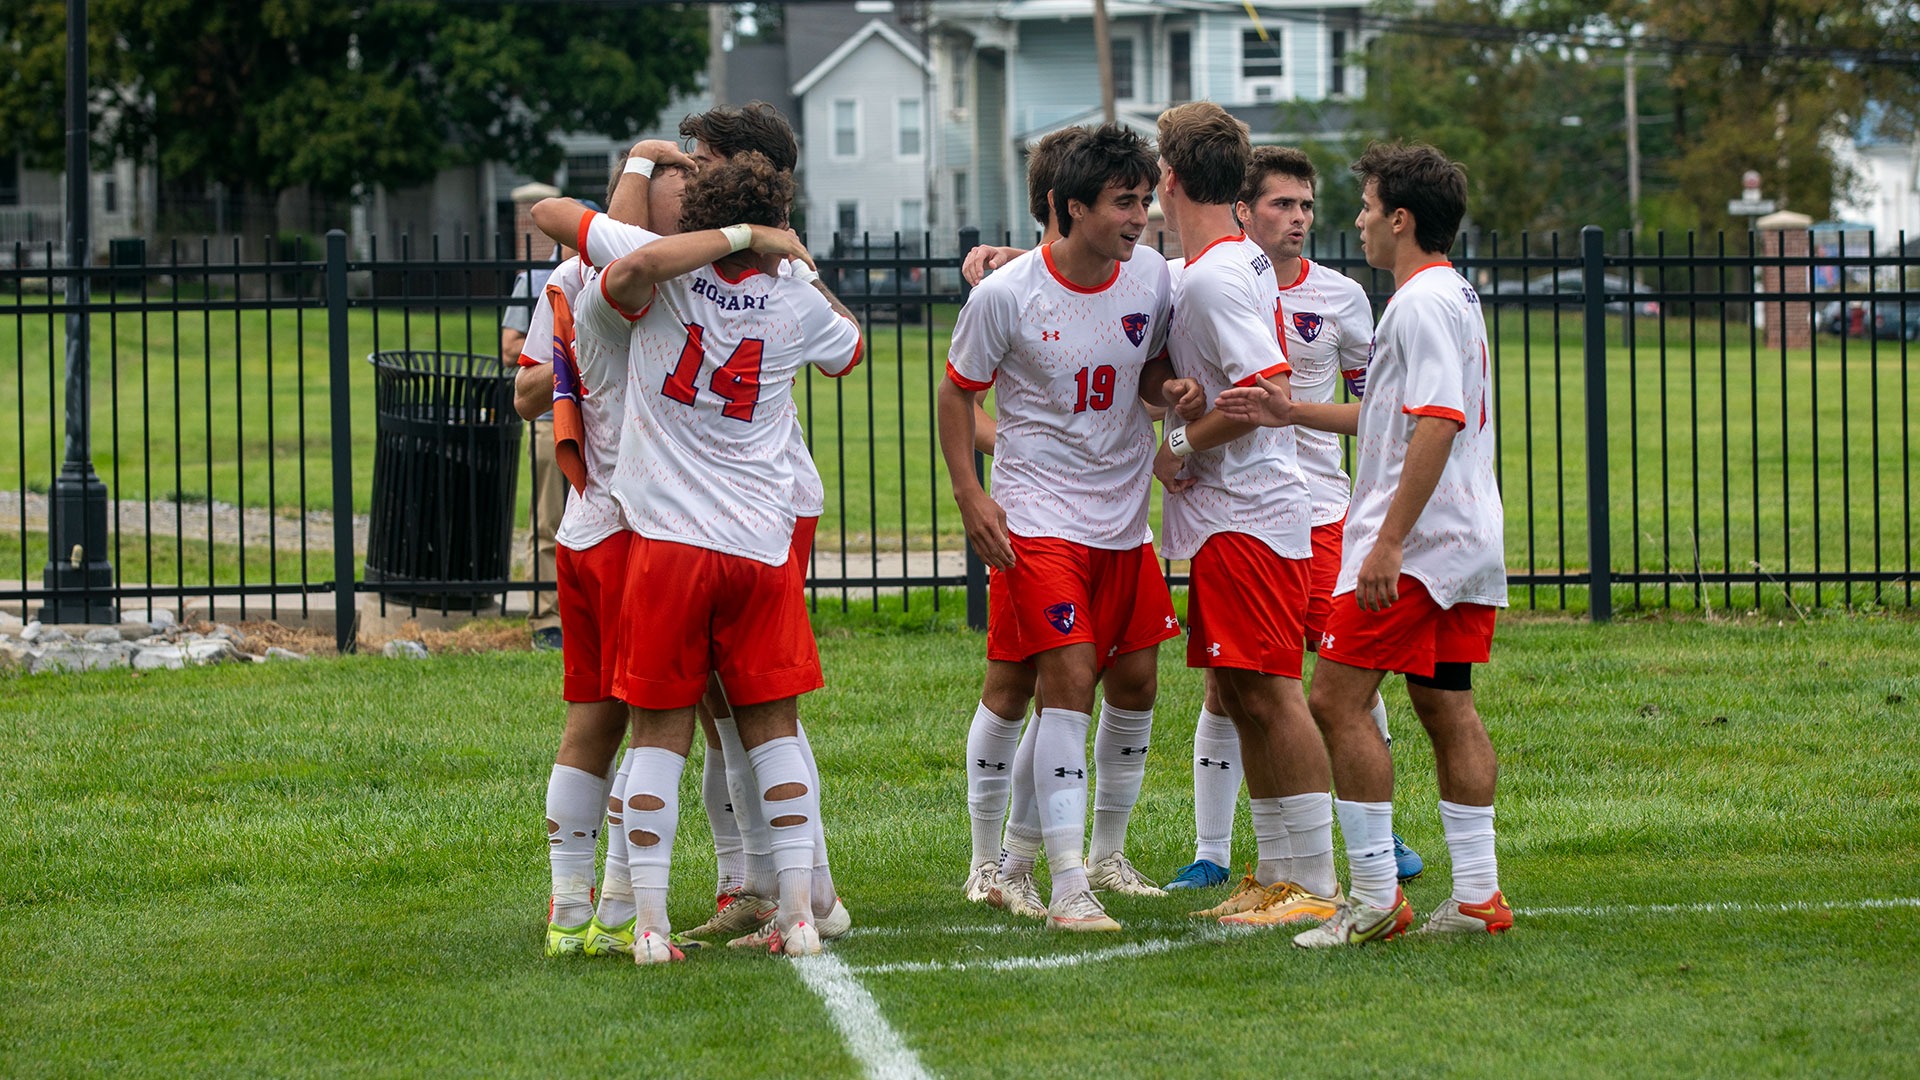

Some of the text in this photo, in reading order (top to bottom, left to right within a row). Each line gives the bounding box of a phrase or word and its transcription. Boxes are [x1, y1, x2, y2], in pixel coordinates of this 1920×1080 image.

[691, 277, 769, 310] HOBART
[661, 322, 764, 423] 14
[1074, 364, 1117, 414] 19
